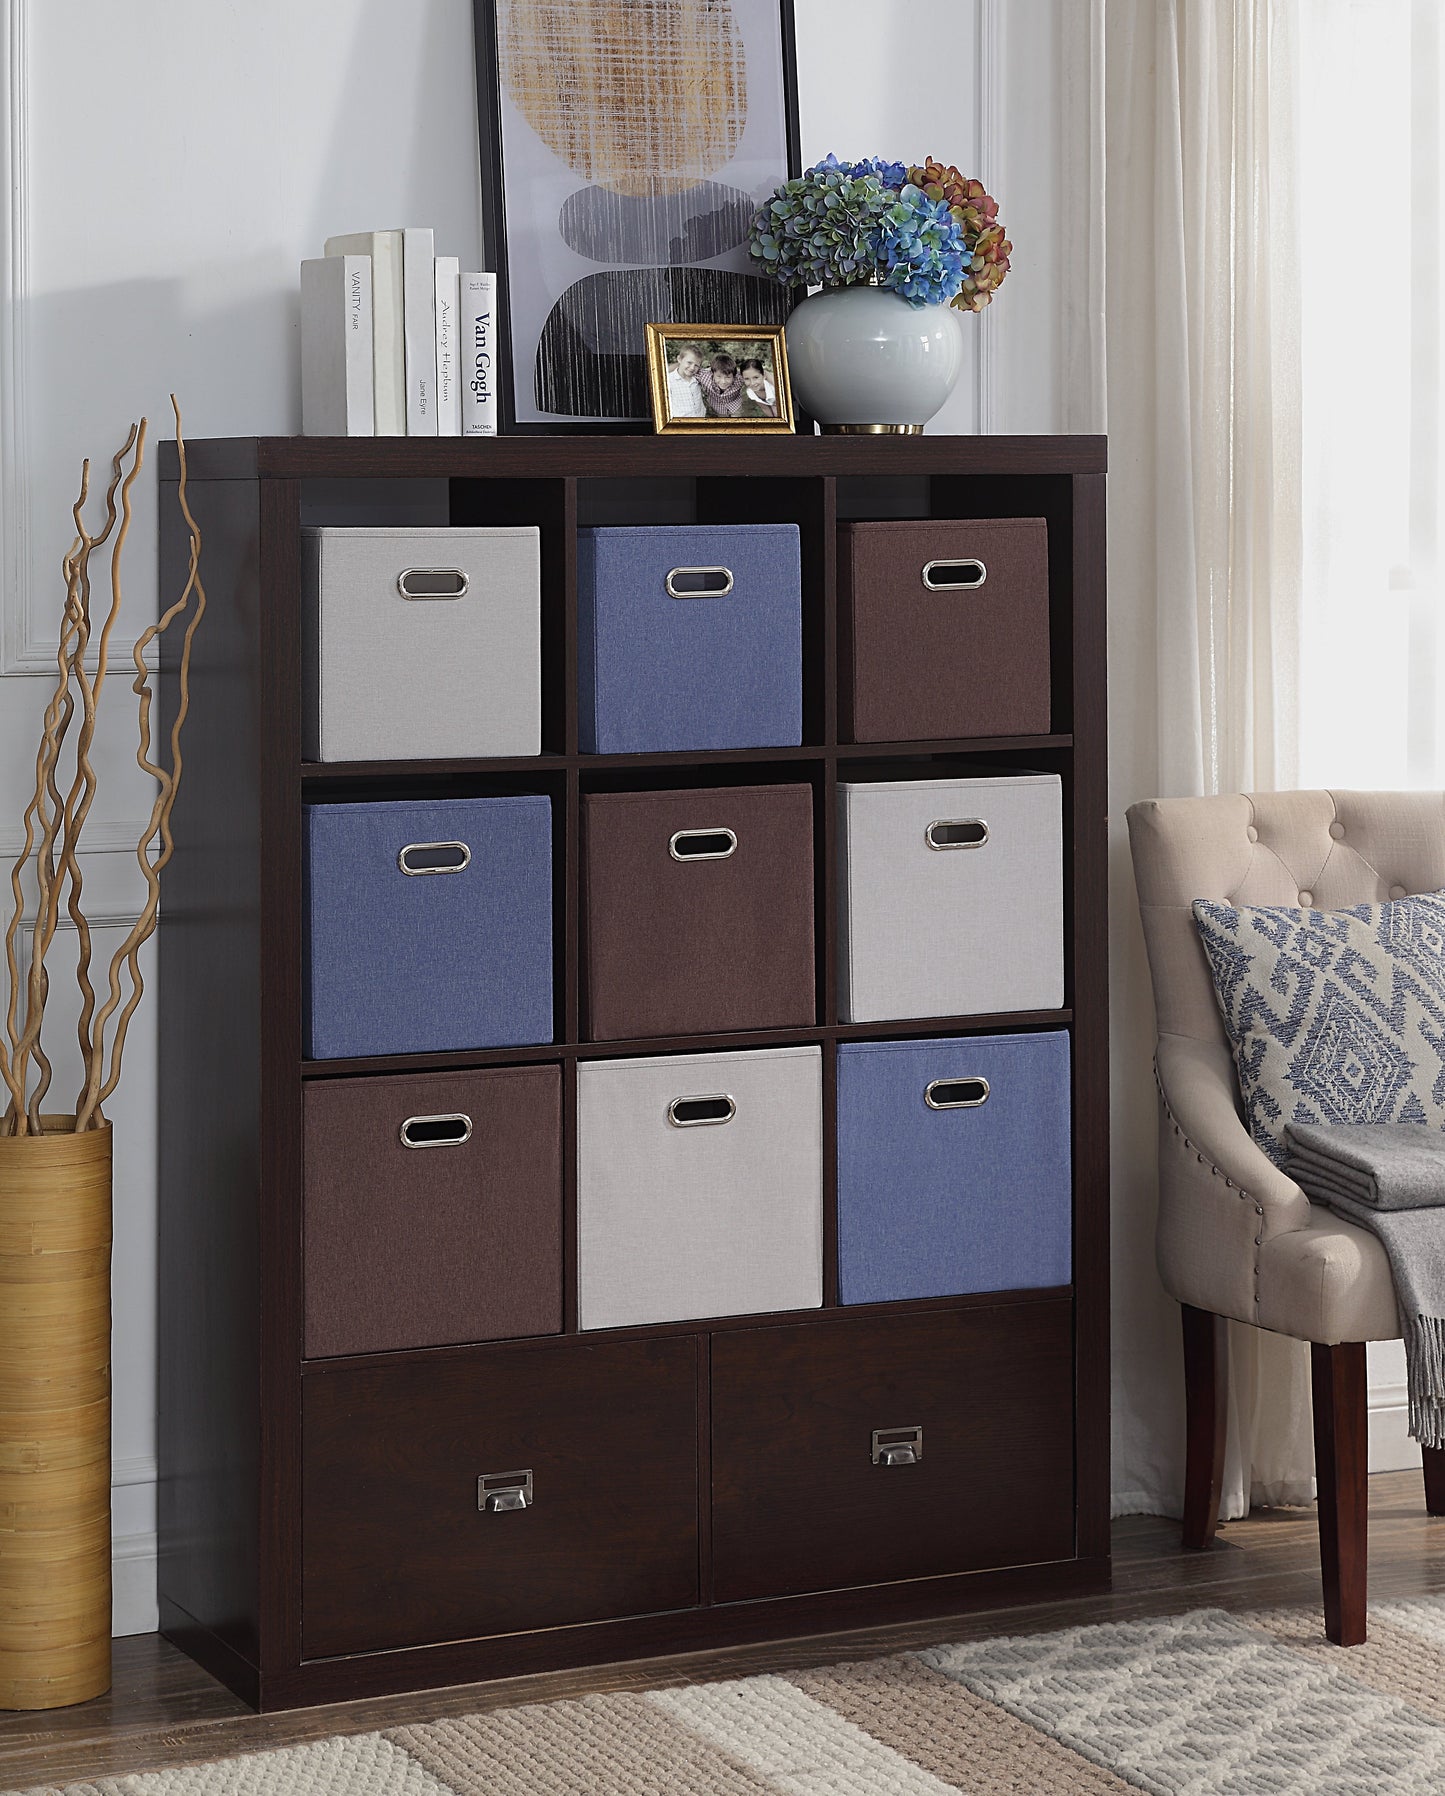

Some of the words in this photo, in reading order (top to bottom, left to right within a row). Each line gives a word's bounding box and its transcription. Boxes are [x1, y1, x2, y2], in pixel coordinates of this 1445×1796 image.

[351, 271, 361, 311] VANITY
[441, 300, 451, 348] Audrey
[475, 312, 490, 348] Van
[419, 379, 427, 397] Jane
[441, 352, 452, 402] Hepburn
[470, 352, 491, 404] Gogh
